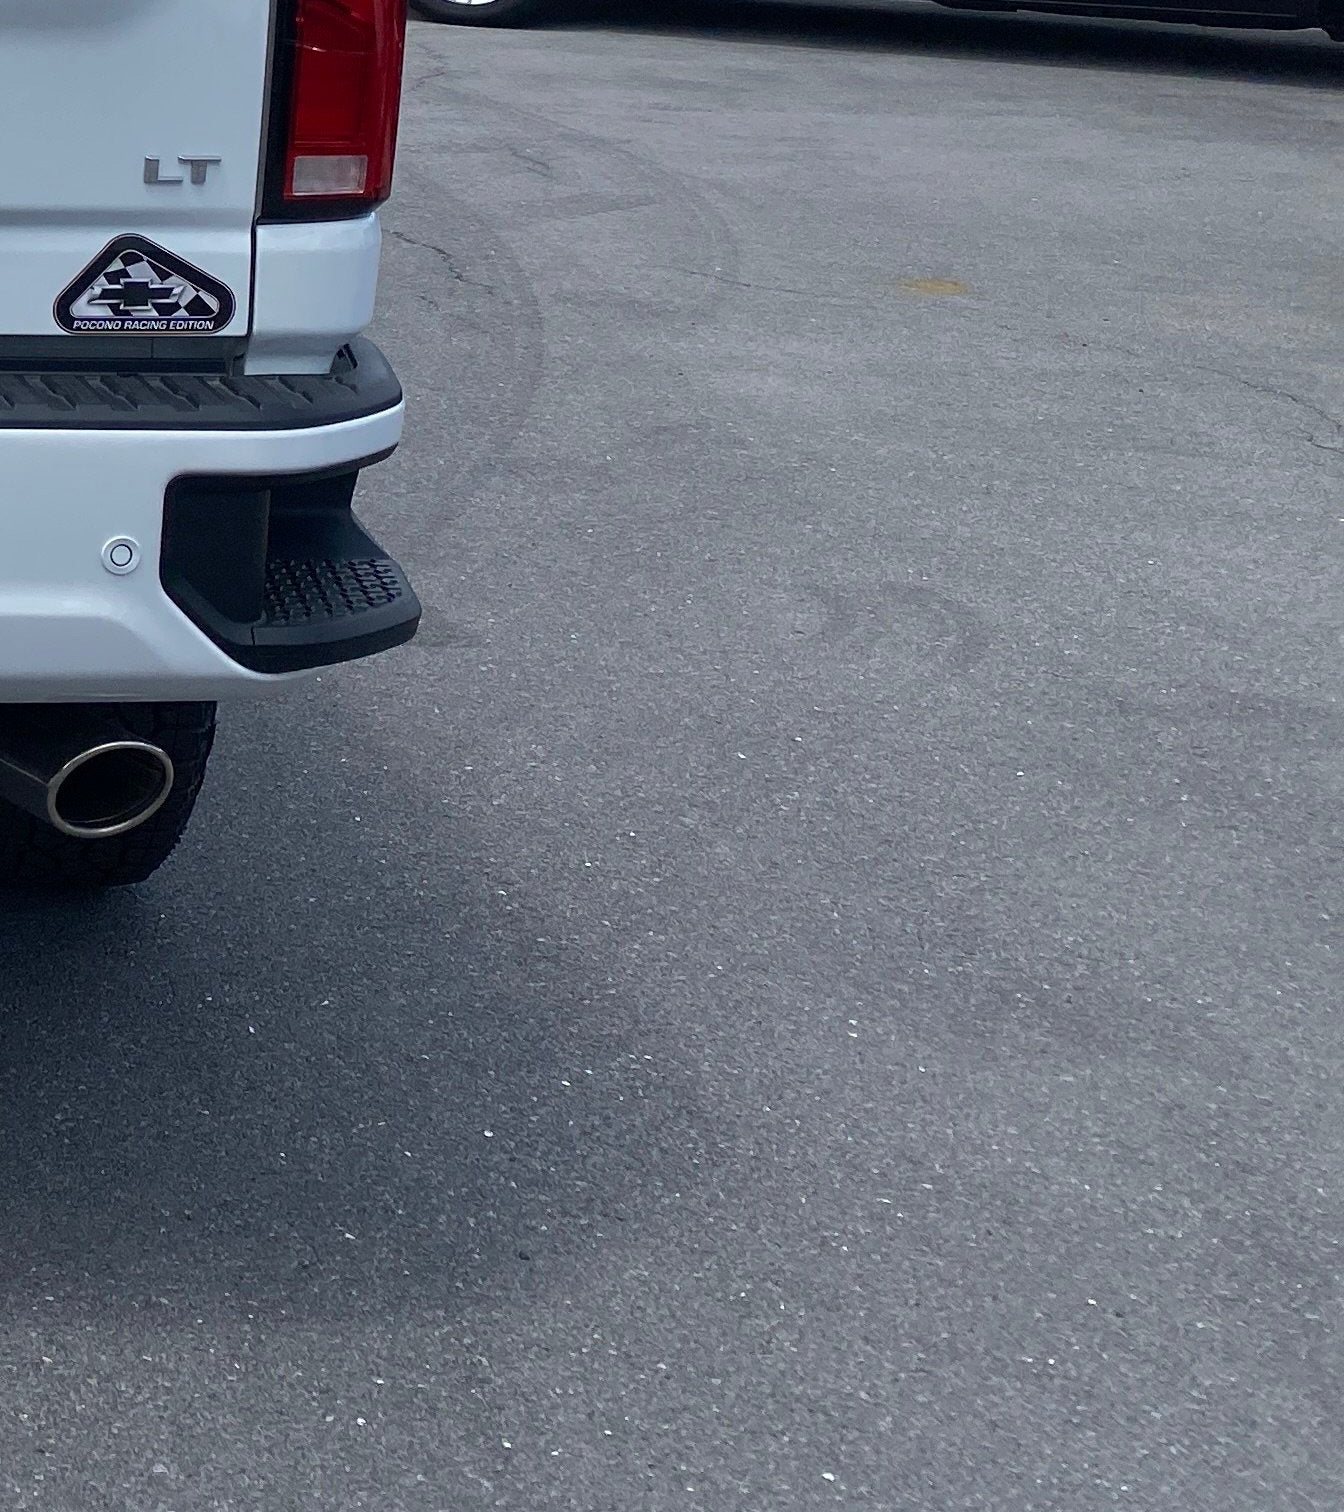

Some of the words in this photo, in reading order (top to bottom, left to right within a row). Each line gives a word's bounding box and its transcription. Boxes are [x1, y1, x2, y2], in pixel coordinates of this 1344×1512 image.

[143, 154, 222, 185] LT
[72, 320, 121, 330] POCONO
[123, 320, 167, 330] RACING
[169, 320, 215, 330] EDITION
